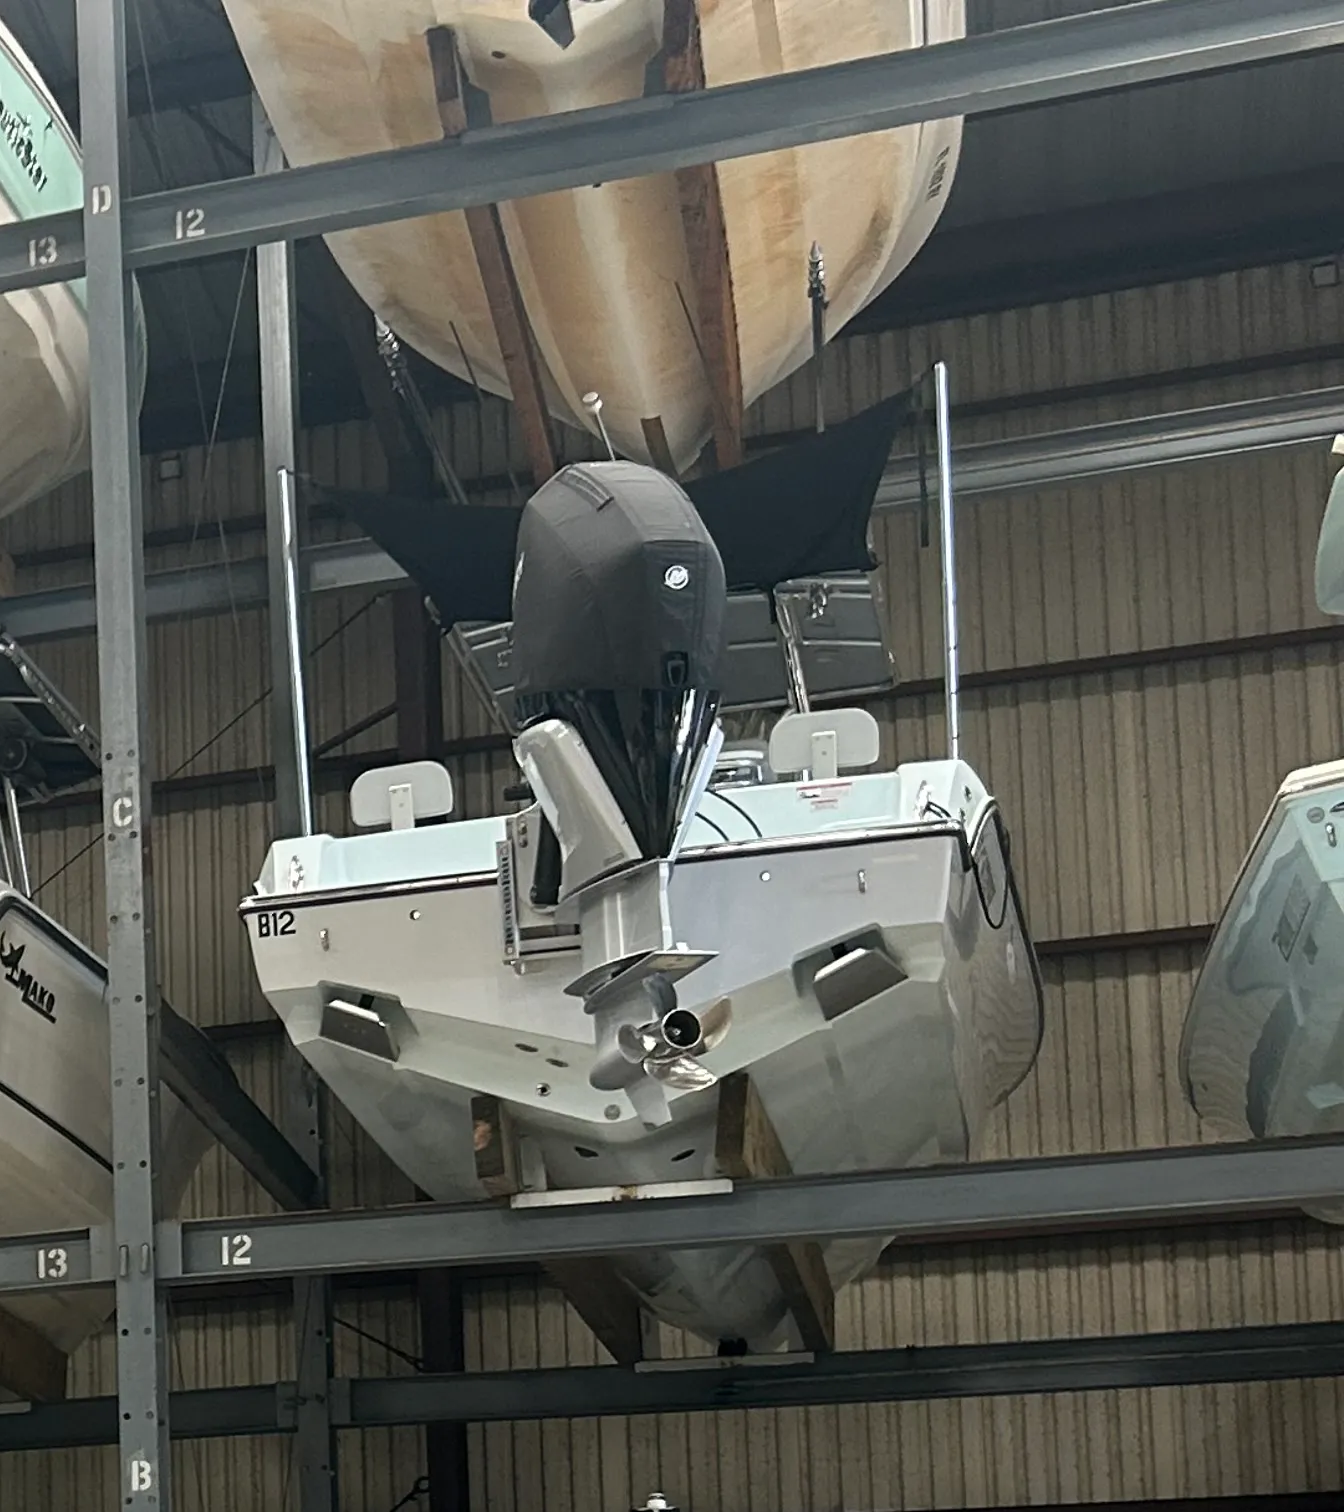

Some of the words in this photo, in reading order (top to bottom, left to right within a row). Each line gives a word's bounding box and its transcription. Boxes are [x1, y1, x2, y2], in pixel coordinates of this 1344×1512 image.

[92, 185, 112, 214] D
[175, 208, 205, 239] 12
[28, 236, 57, 267] 13
[112, 797, 132, 827] C
[258, 911, 296, 938] B12
[37, 1248, 68, 1279] 13
[221, 1234, 252, 1266] 12
[131, 1460, 152, 1492] B
